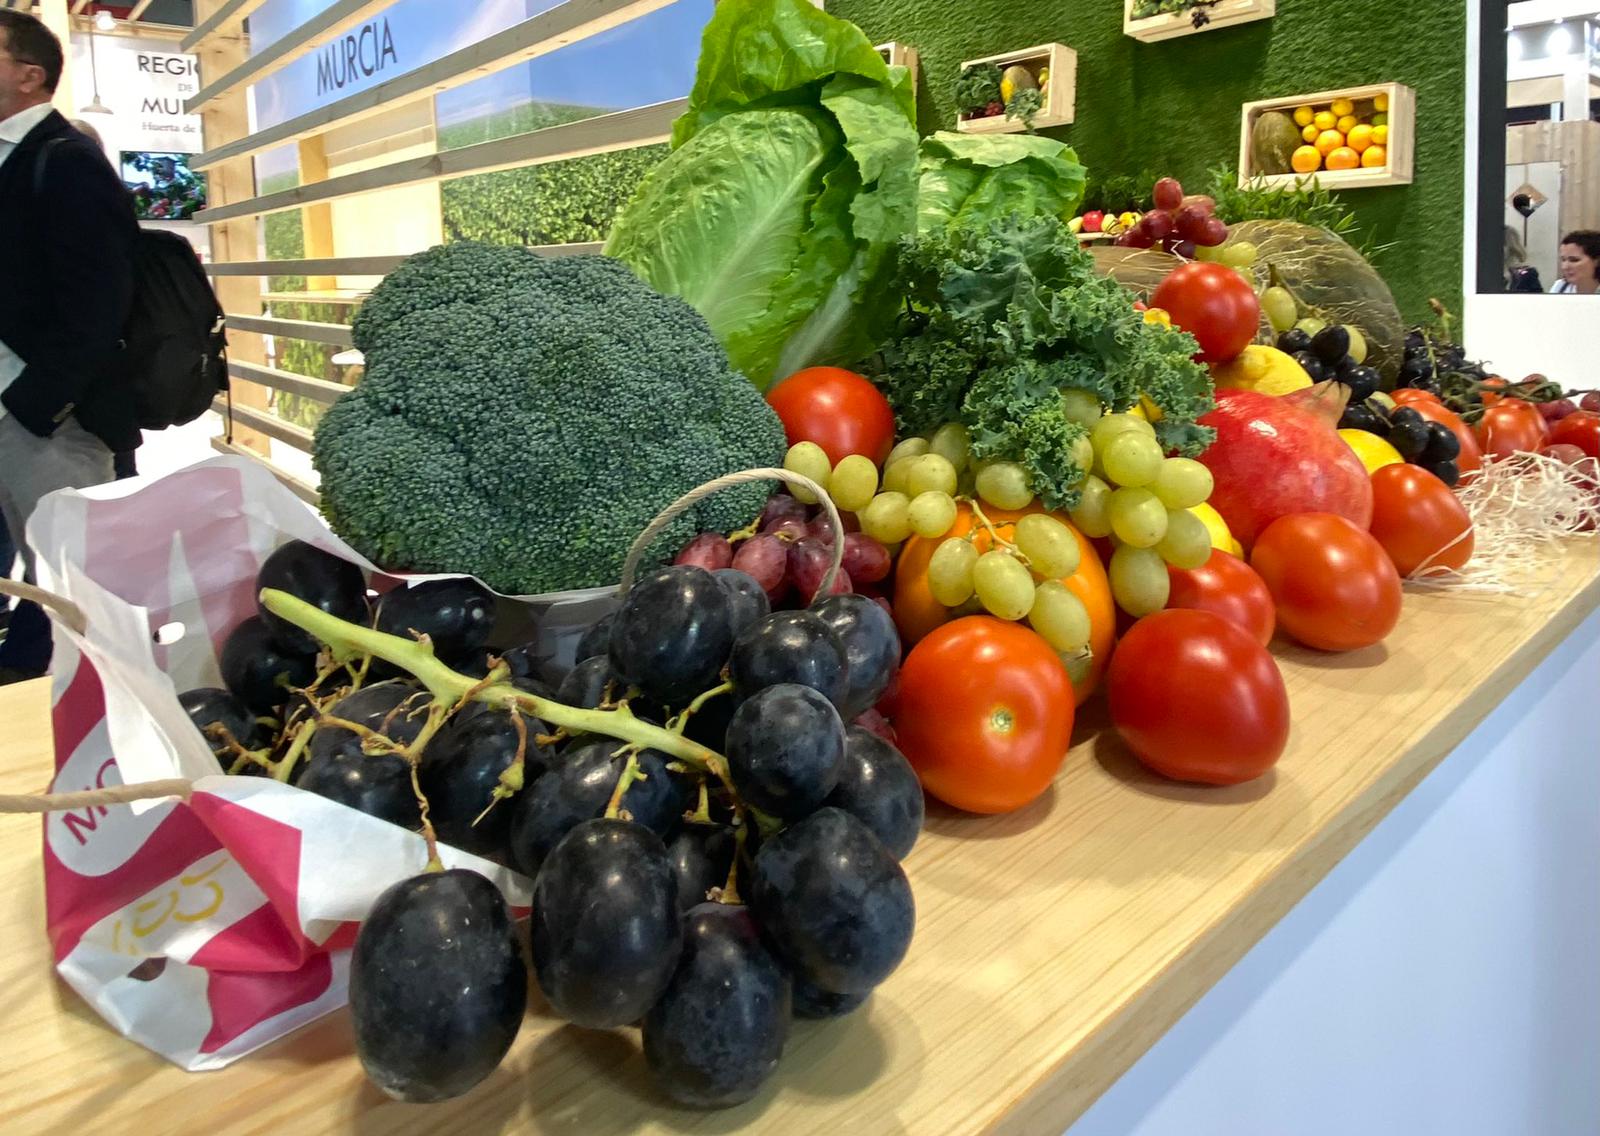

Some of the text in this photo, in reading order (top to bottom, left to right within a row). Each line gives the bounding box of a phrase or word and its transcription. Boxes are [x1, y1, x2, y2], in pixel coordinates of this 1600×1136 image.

[317, 15, 397, 96] MURCIA
[177, 82, 193, 93] DE
[141, 97, 182, 115] MU
